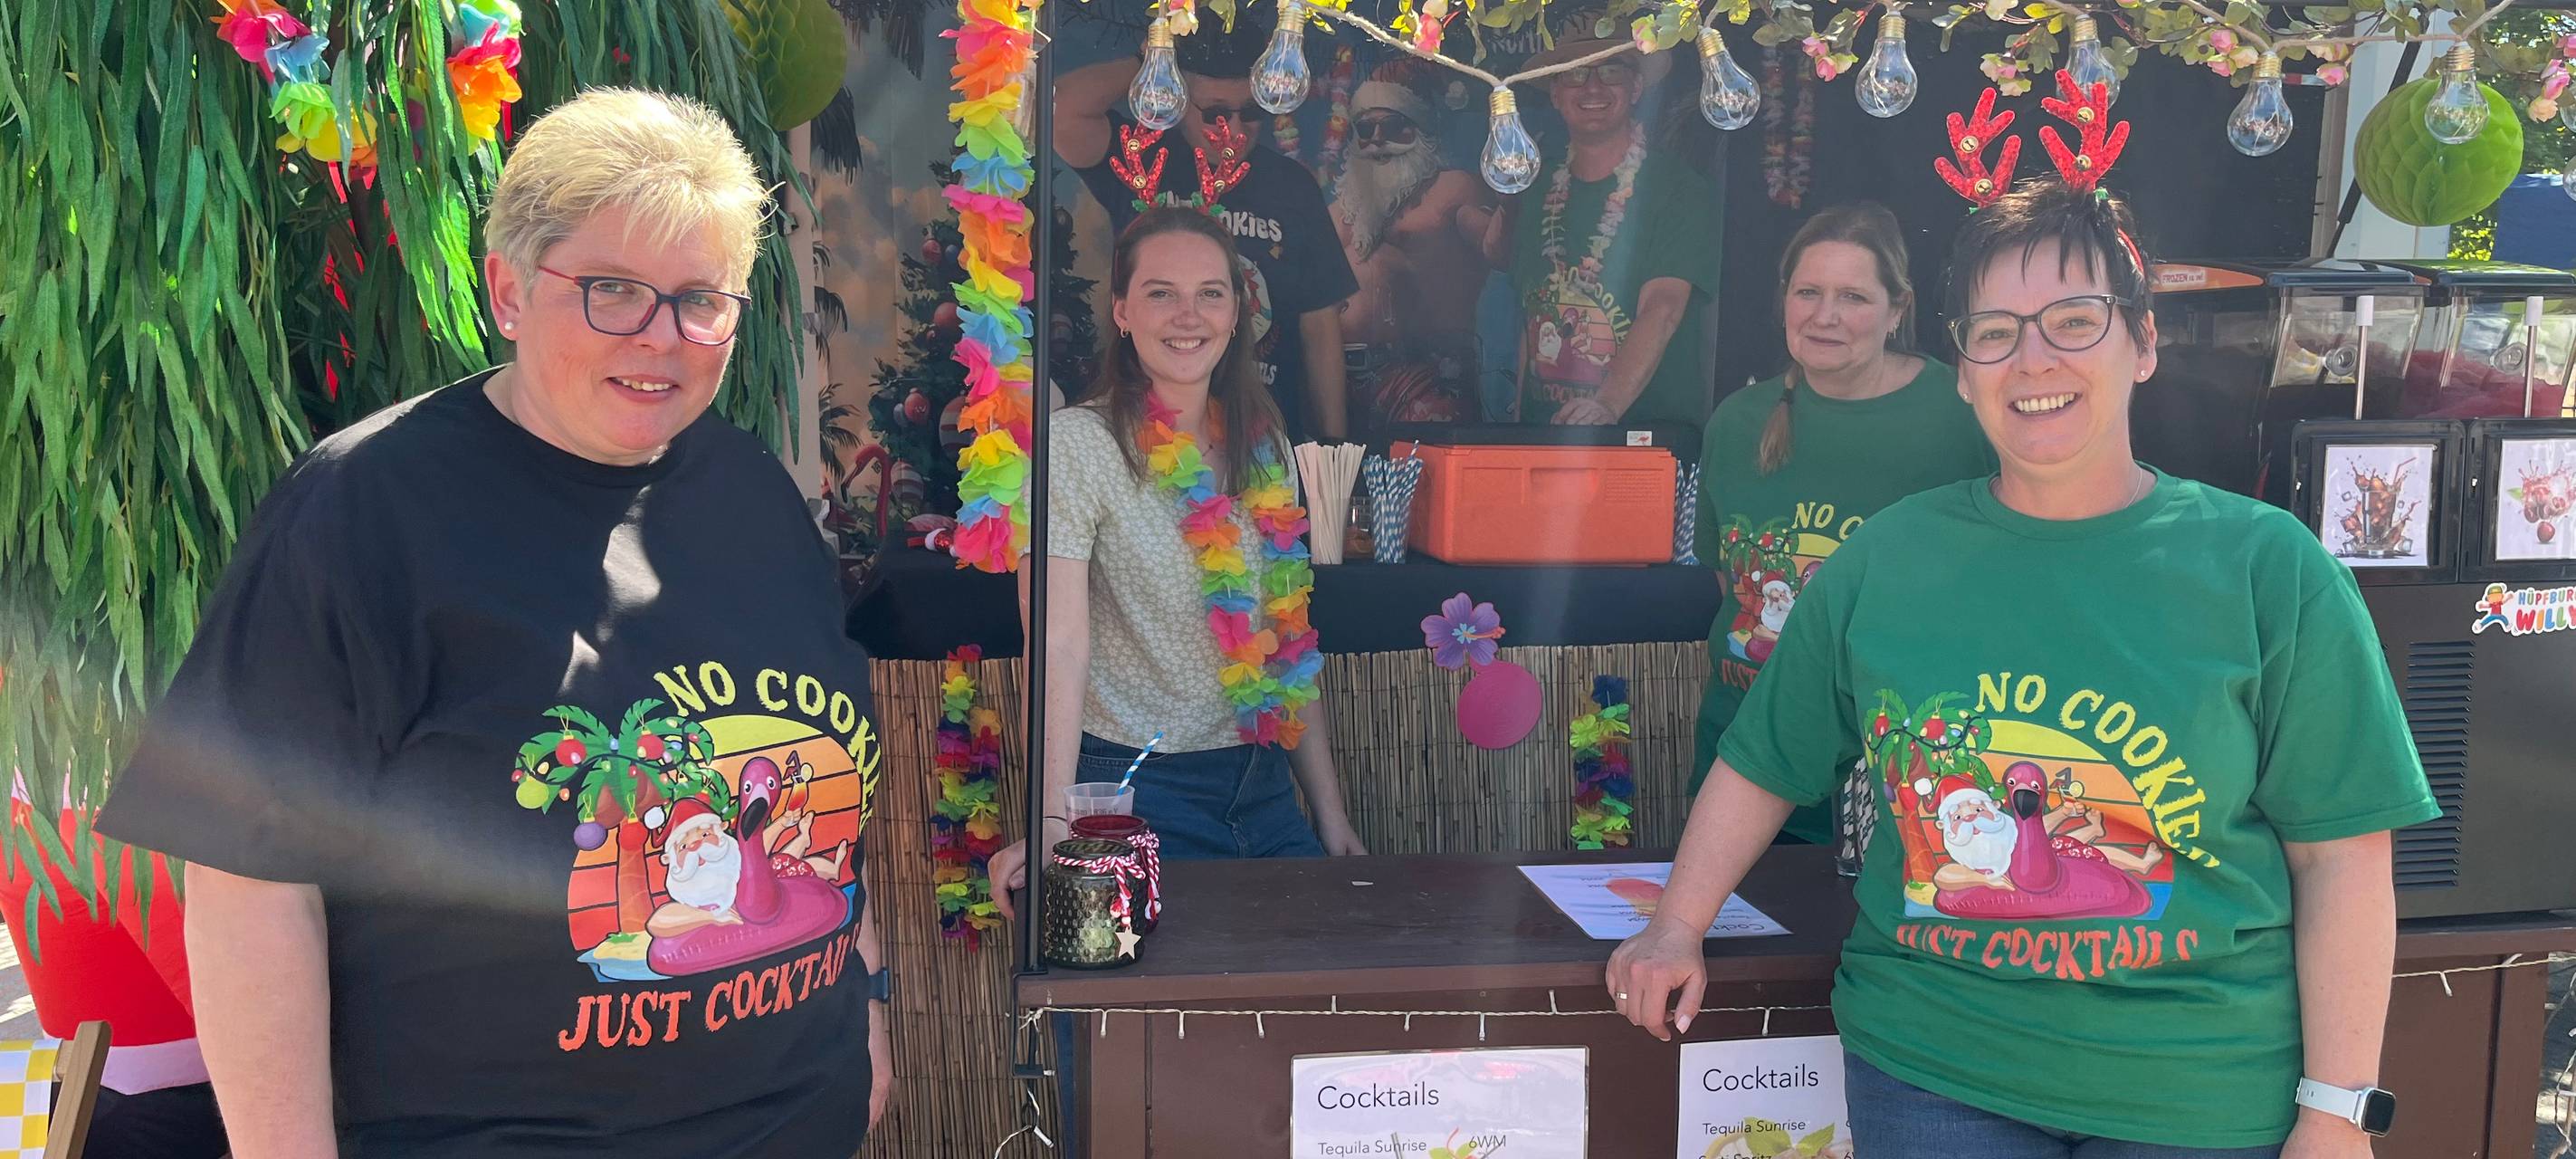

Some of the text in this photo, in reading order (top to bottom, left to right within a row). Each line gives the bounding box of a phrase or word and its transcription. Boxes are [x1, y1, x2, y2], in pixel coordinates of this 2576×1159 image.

[1791, 502, 1835, 529] NO
[2518, 589, 2576, 606] HÜPFBUR
[654, 661, 736, 716] NO
[1975, 672, 2046, 714] NO
[558, 922, 861, 1051] JUST COCKTAI
[1703, 1063, 1818, 1092] Cocktails
[1318, 1081, 1439, 1110] Cocktails
[1703, 1119, 1806, 1138] Tequila Sunrise
[1318, 1135, 1507, 1158] Tequila Sunrise 6WM
